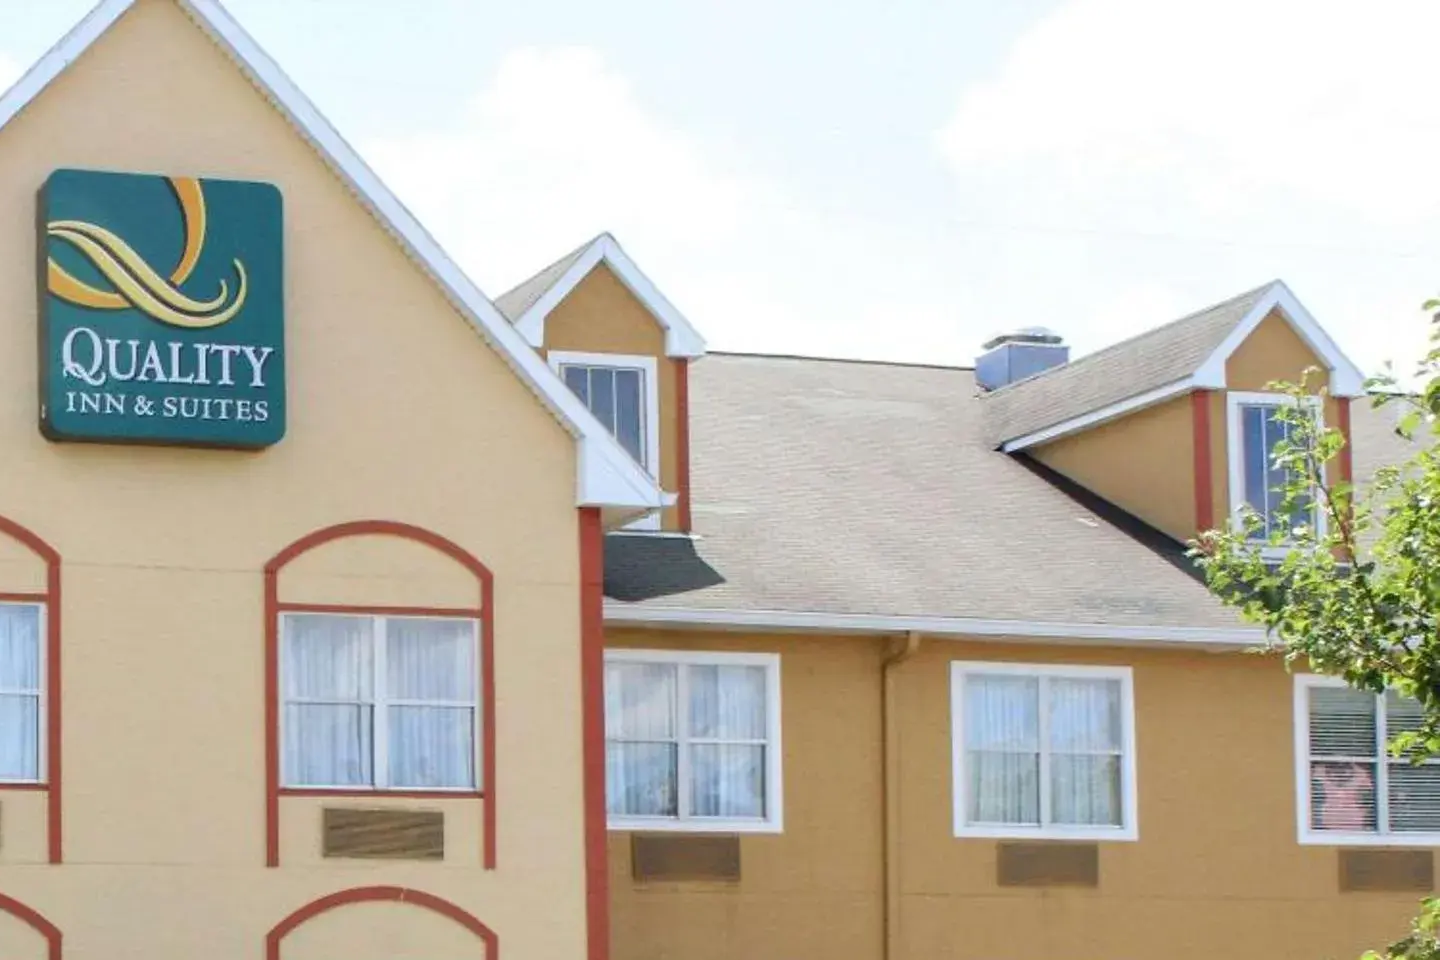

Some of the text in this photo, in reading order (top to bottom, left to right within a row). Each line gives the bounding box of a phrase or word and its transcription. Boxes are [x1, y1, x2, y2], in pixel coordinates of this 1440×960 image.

[62, 327, 274, 387] QUALITY
[65, 391, 269, 421] INN & SUITES
